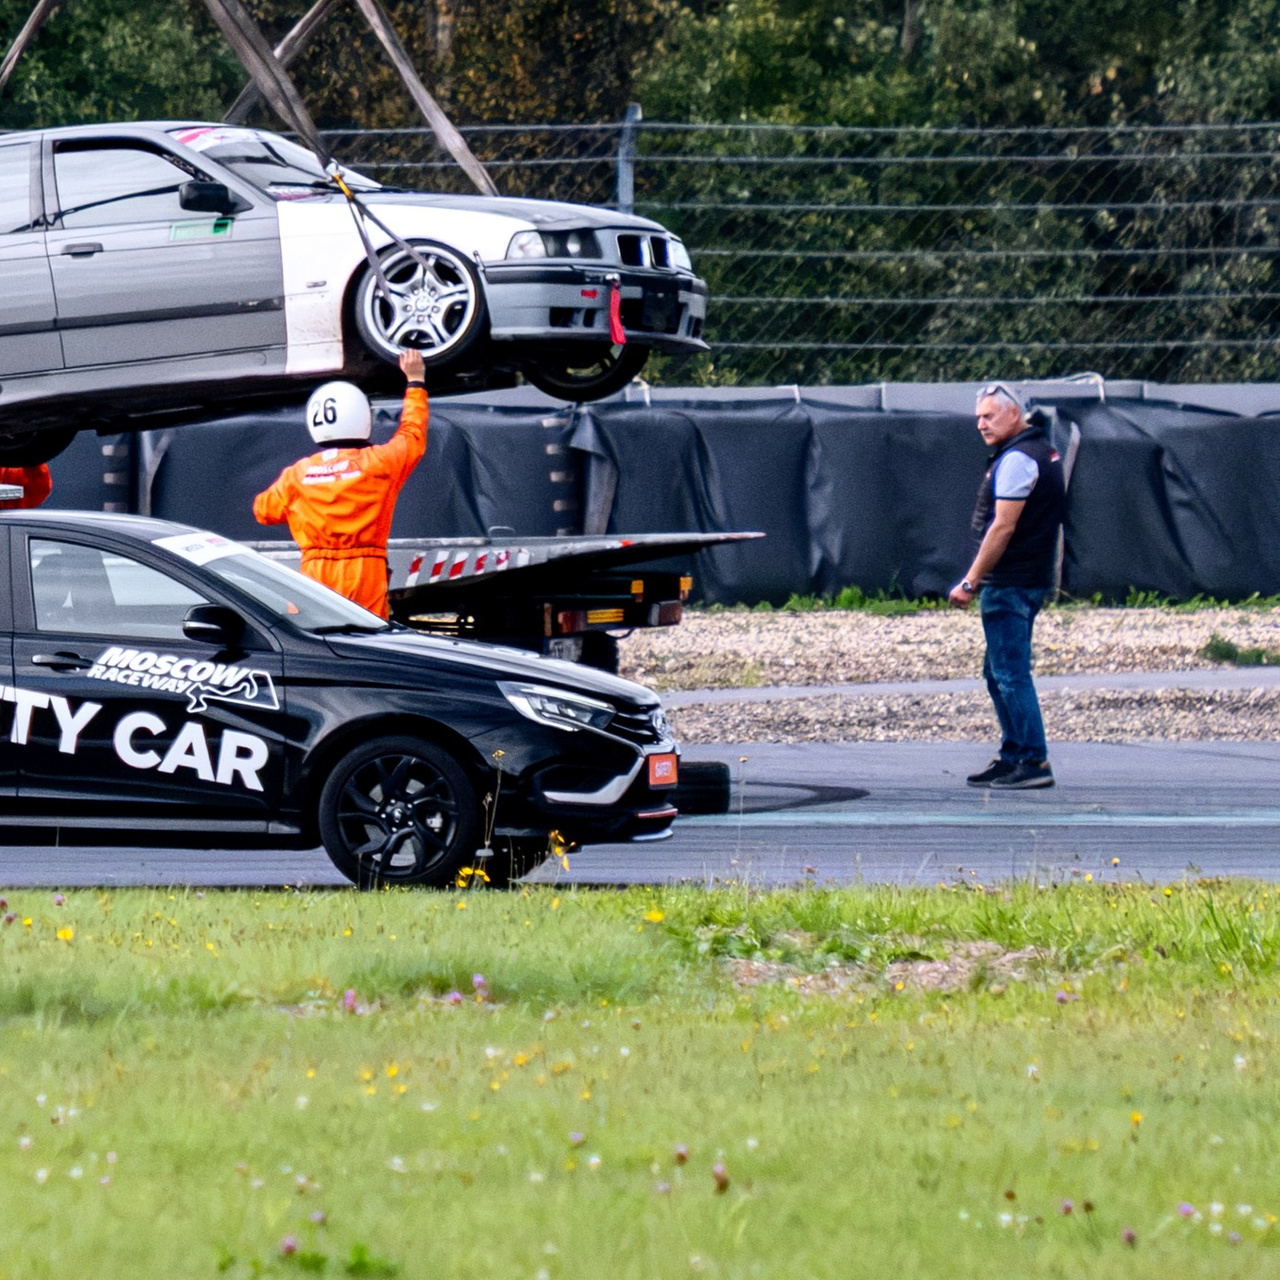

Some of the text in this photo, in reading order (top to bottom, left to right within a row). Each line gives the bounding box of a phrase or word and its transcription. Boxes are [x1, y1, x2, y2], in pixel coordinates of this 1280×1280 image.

[311, 397, 337, 427] 26
[86, 664, 193, 693] RACEWAY
[97, 646, 252, 688] MOSCOW
[114, 711, 269, 792] CAR
